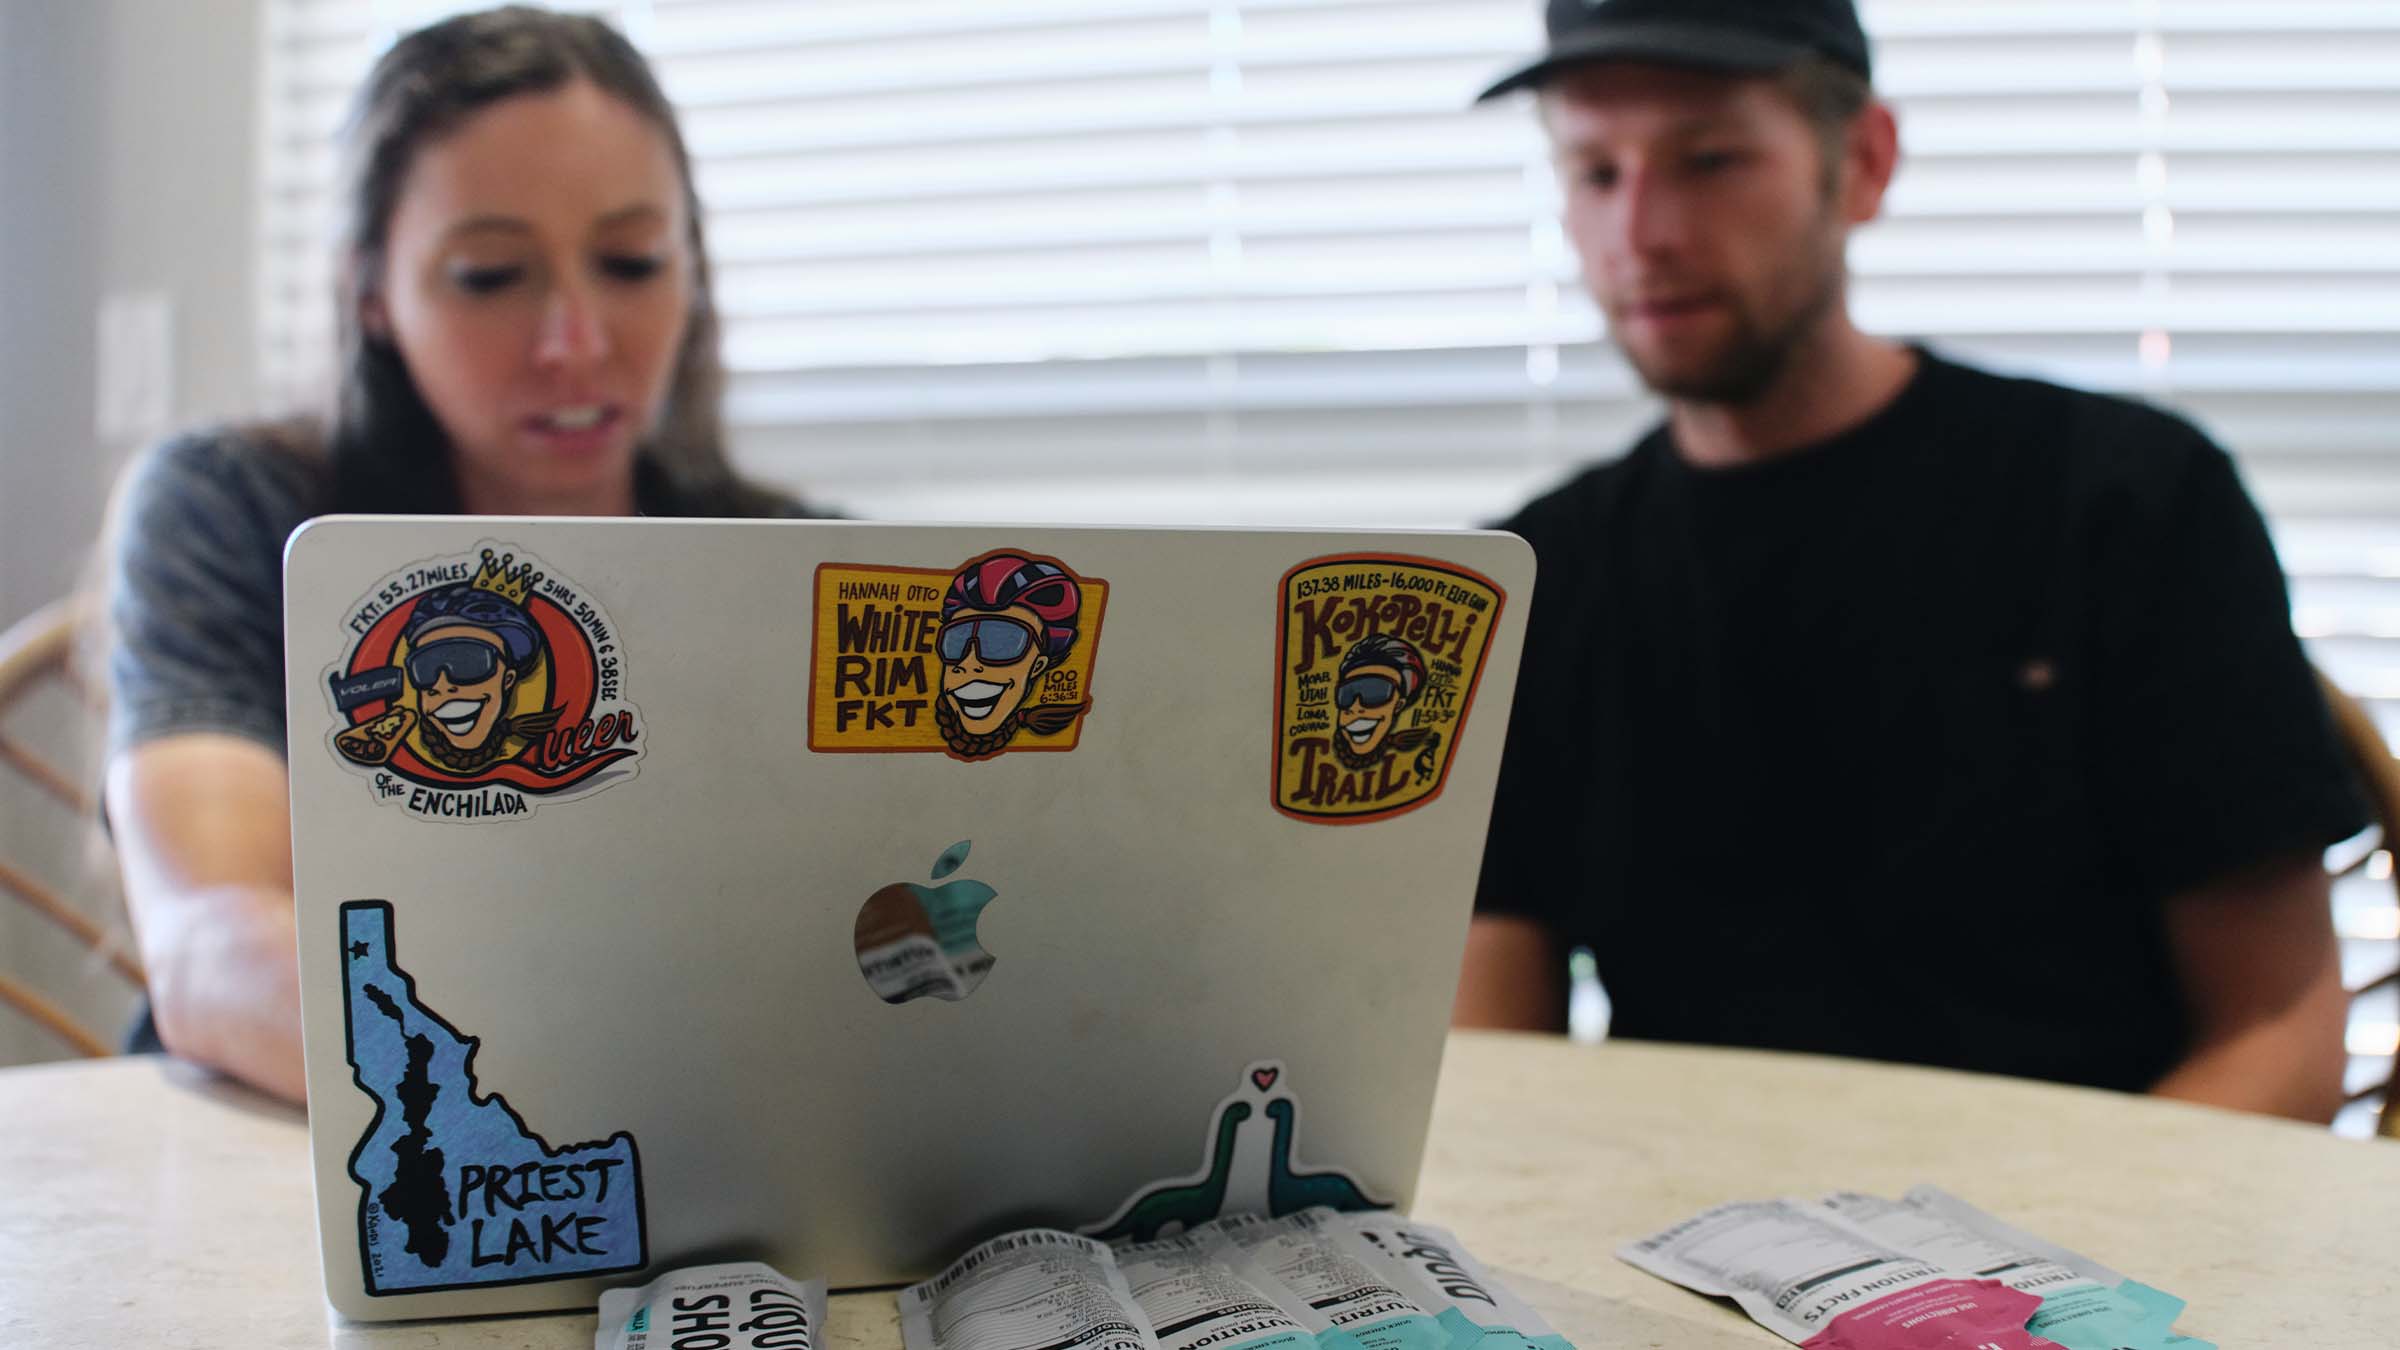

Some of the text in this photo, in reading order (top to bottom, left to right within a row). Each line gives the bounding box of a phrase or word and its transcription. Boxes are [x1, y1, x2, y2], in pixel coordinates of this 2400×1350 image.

[839, 582, 940, 601] HANNAH OTTO
[1297, 576, 1340, 599] 137.38
[350, 601, 383, 634] FKT:
[574, 602, 610, 643] 50MIN
[600, 657, 619, 701] 38SEC
[834, 655, 929, 699] RIM
[1043, 681, 1077, 692] MILES
[1045, 670, 1078, 683] 100
[1300, 687, 1329, 702] UTAH
[1423, 686, 1457, 709] FKT
[836, 699, 929, 733] FKT
[375, 773, 393, 785] OF
[1289, 736, 1411, 806] TRAIL
[376, 783, 406, 799] THE
[408, 788, 528, 818] ENCHILADA
[458, 1158, 624, 1219] PRIEST
[470, 1211, 609, 1267] LAKE
[371, 1253, 384, 1278] 2021
[738, 1289, 809, 1350] LIQU
[1804, 1290, 1861, 1323] FACTS
